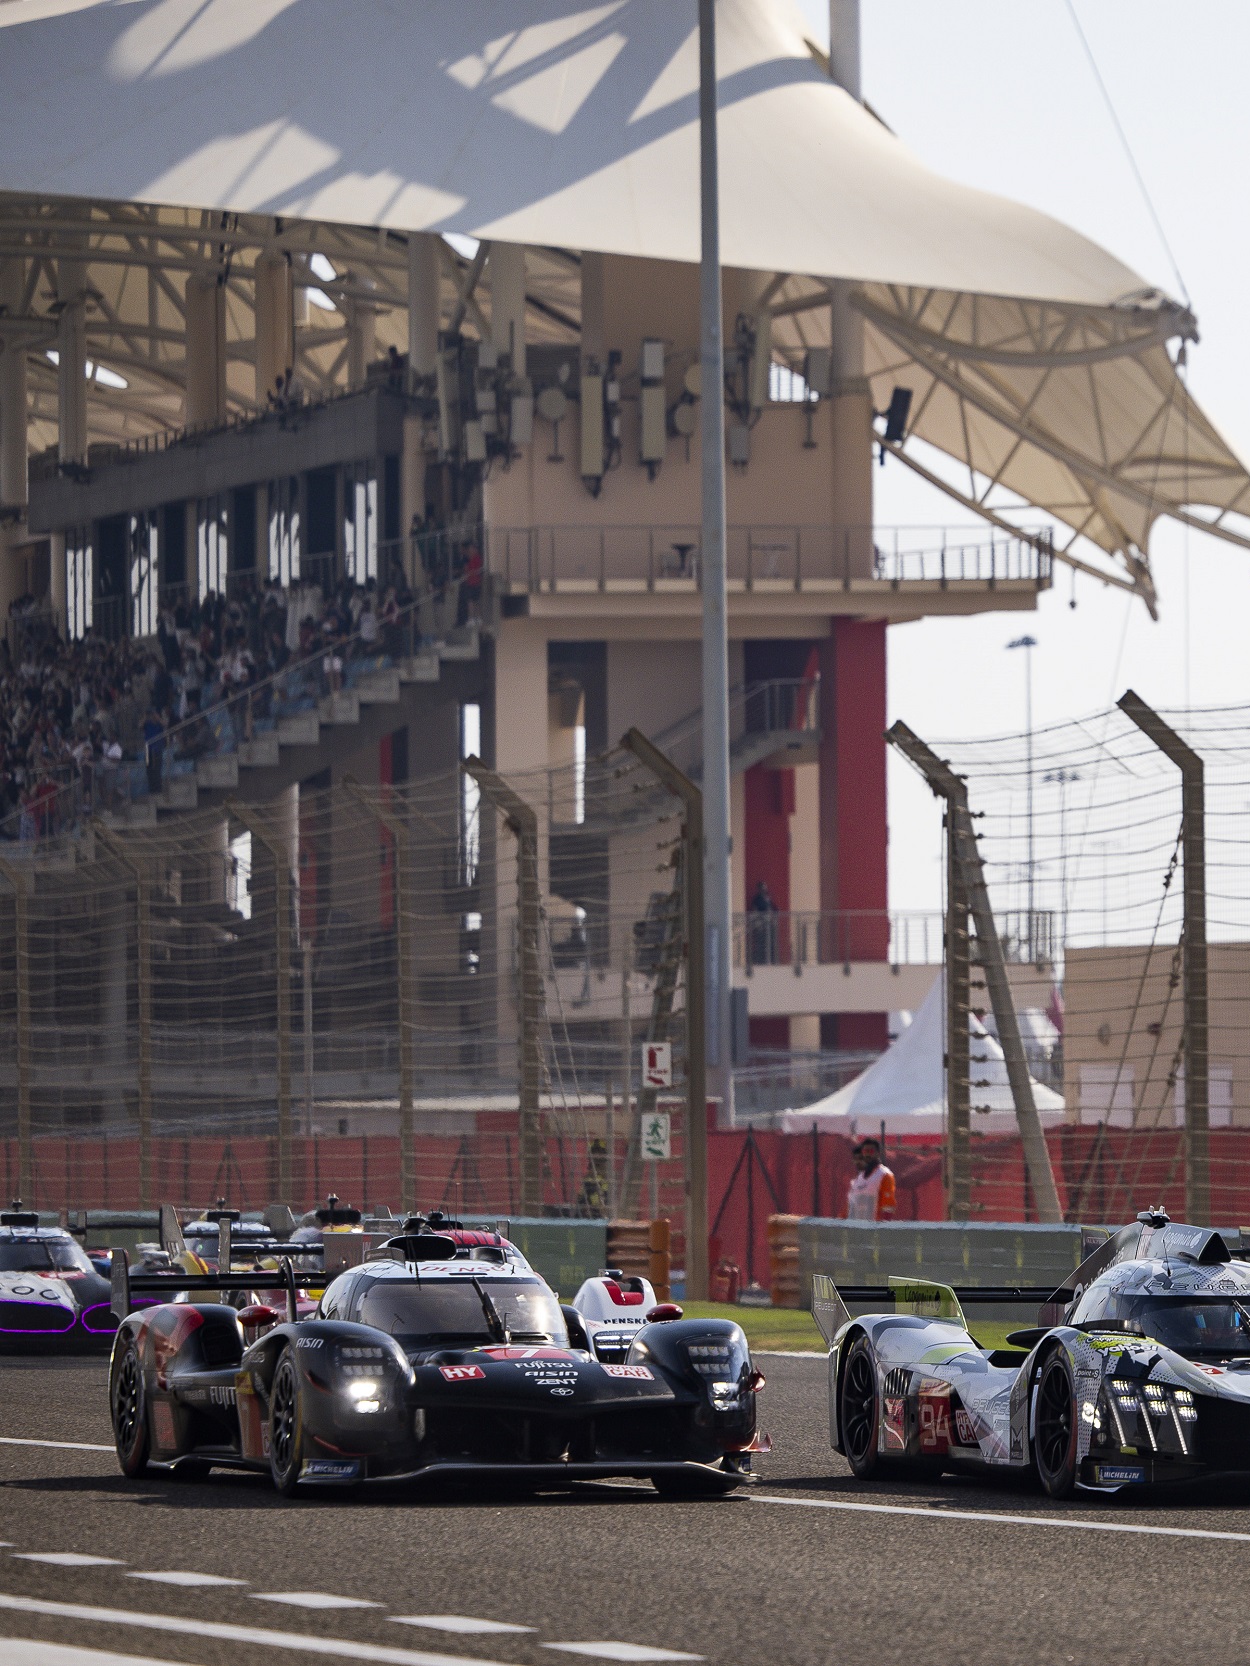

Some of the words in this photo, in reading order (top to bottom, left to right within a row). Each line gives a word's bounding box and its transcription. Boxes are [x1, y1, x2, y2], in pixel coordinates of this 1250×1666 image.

[448, 1368, 477, 1379] HY
[209, 1386, 237, 1409] FUJIT
[921, 1403, 954, 1447] 94
[313, 1465, 354, 1473] MICHELIN
[1103, 1471, 1140, 1480] MICHELIN
